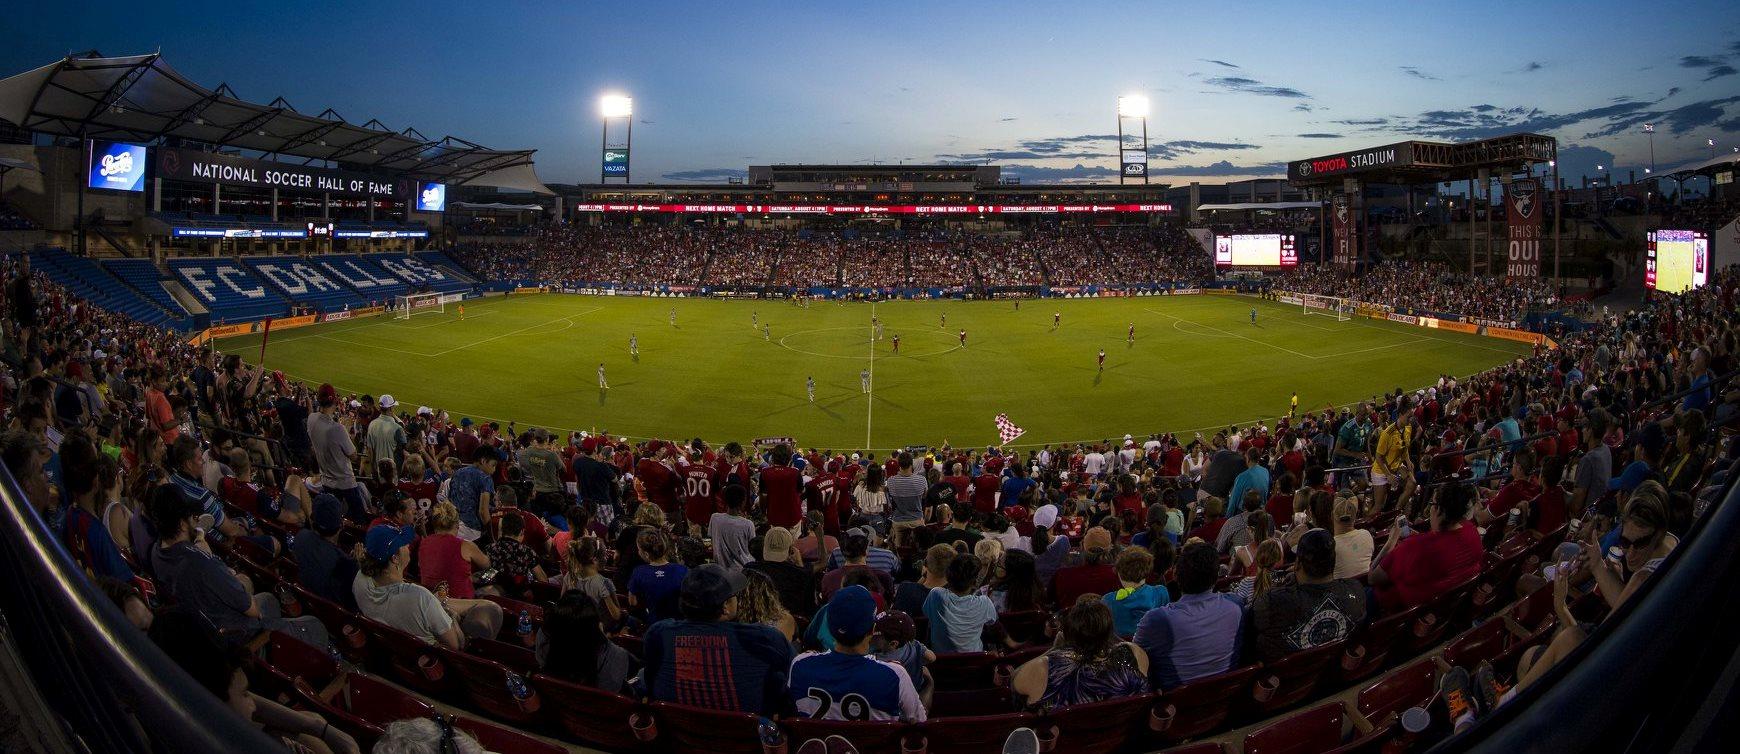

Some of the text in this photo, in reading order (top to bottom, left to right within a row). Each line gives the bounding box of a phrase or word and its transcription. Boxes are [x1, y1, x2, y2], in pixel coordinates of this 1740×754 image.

[1312, 149, 1395, 173] TOYOTA STADIUM
[192, 162, 393, 195] NATIONAL SOCCER HALL OF FAME
[1509, 224, 1532, 238] THIS
[179, 259, 446, 302] FC DALLAS
[687, 477, 710, 497] 00
